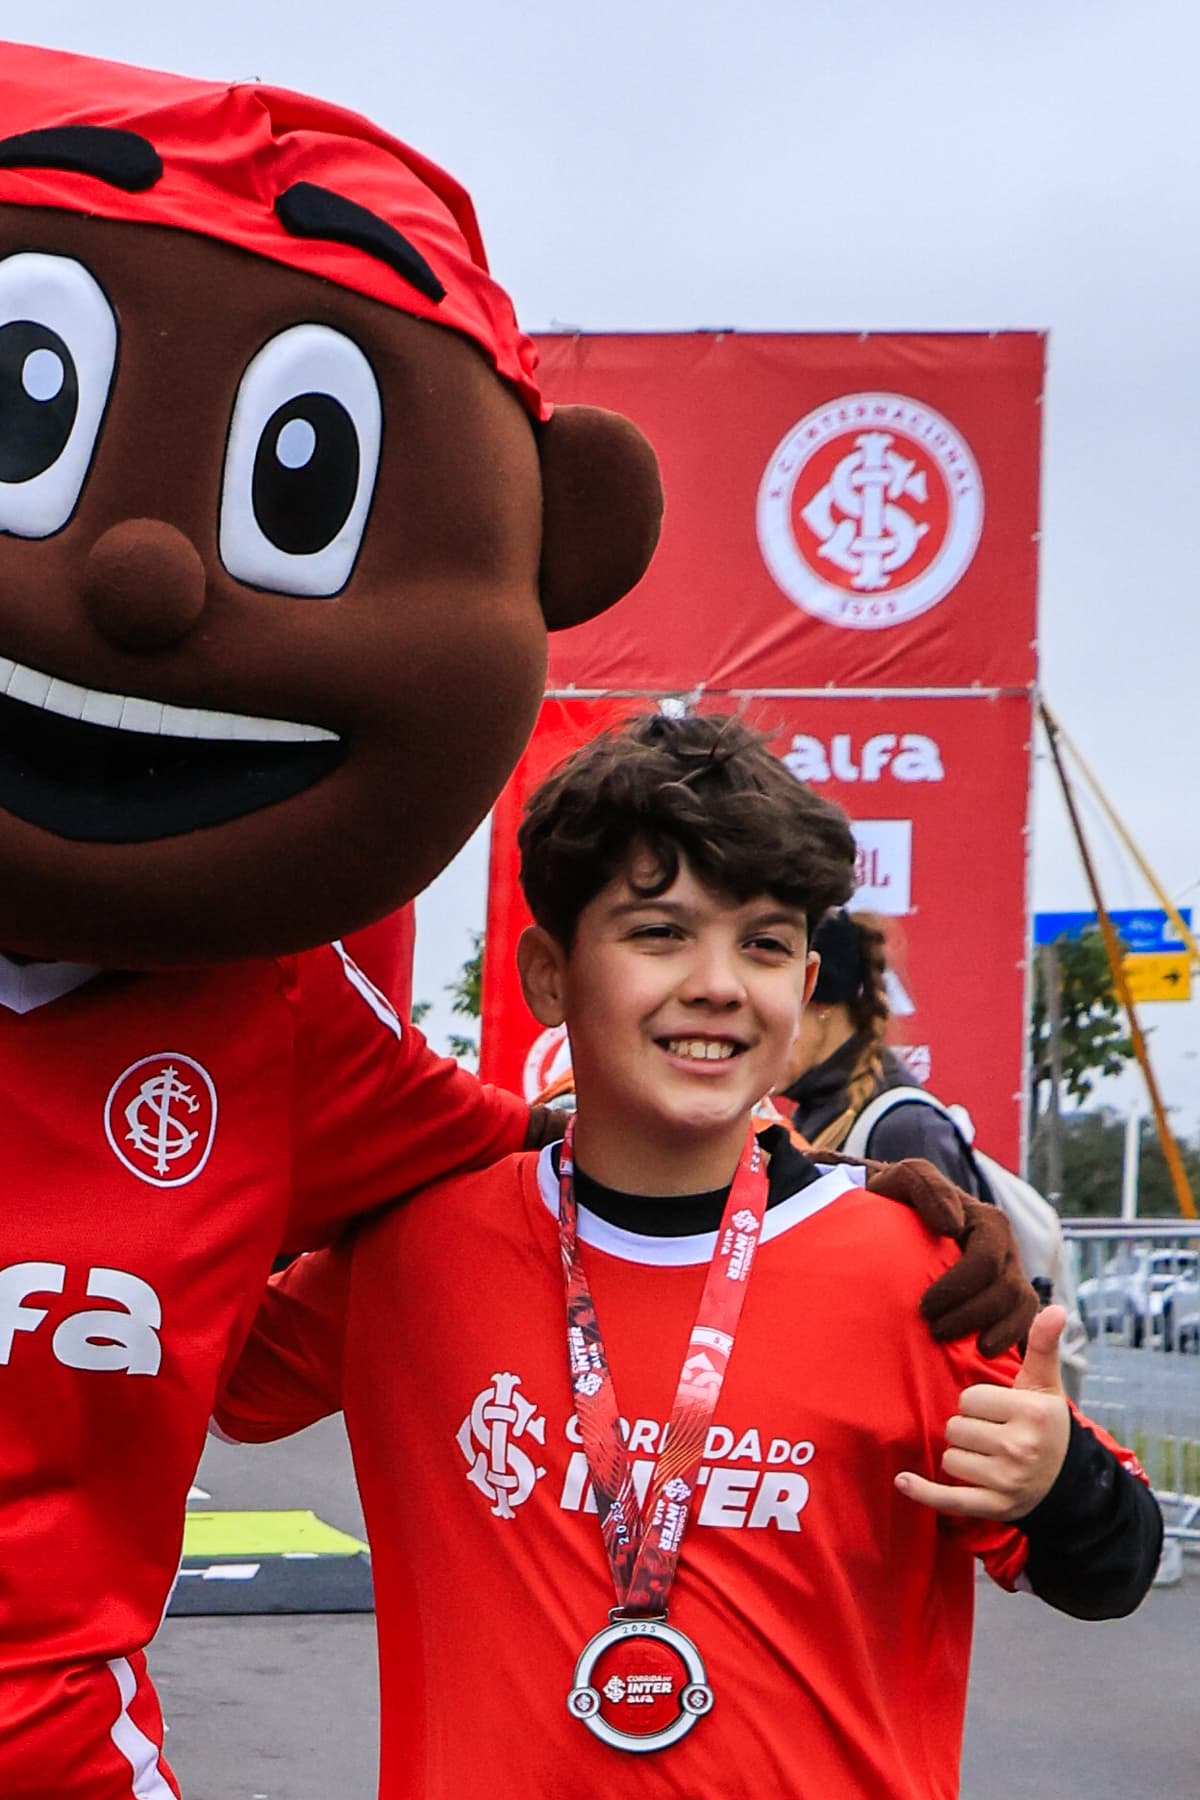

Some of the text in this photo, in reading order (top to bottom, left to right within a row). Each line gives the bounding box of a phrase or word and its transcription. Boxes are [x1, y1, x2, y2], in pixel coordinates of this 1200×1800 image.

[781, 732, 946, 783] alfa
[726, 1232, 750, 1280] INTER
[564, 1413, 816, 1467] CRDA DO
[559, 1450, 810, 1533] IER
[658, 1502, 681, 1551] INTER
[622, 1624, 657, 1634] 2025
[627, 1682, 672, 1694] INTER
